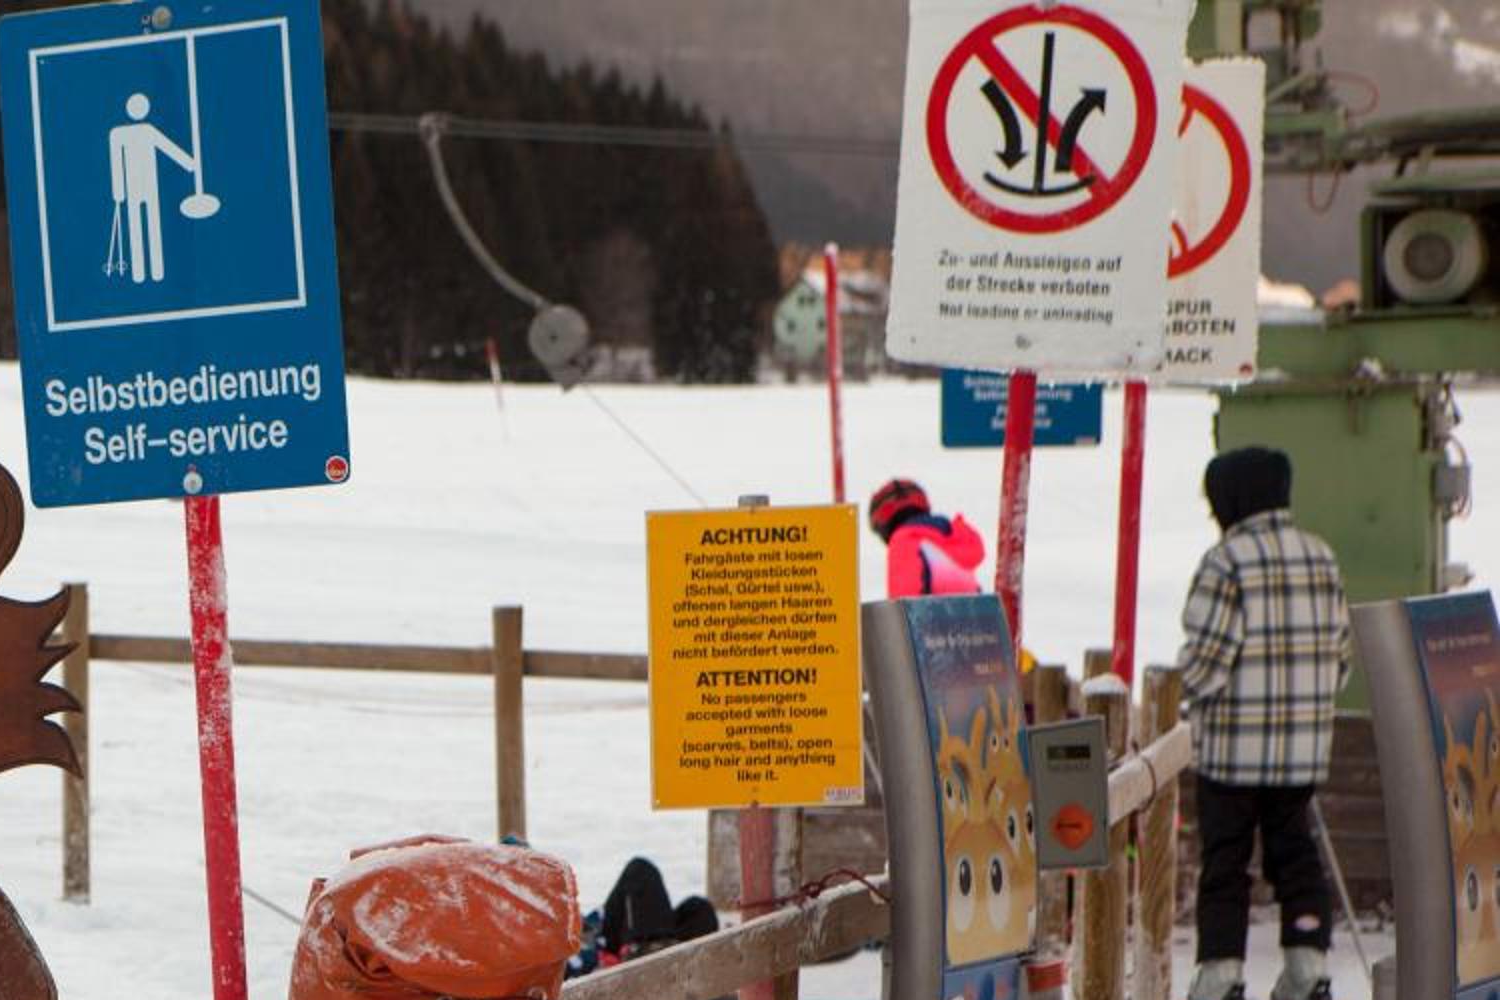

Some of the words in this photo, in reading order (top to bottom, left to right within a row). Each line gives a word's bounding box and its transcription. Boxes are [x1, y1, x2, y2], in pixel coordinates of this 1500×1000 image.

[969, 253, 998, 268] und
[1003, 252, 1092, 273] Aussteigen
[1096, 256, 1122, 272] auf
[946, 275, 972, 292] der
[977, 275, 1036, 294] Strecke
[1041, 277, 1111, 296] verboten
[45, 363, 322, 418] Selbstbedienung
[84, 413, 289, 465] Self-service
[701, 525, 809, 545] ACHTUNG!
[684, 551, 755, 567] Fahrgäste
[757, 550, 781, 562] mit
[785, 550, 824, 561] losen
[691, 565, 818, 582] Kleidungsstücken
[685, 583, 733, 598] (Schal,
[737, 582, 781, 595] Gürtel
[784, 580, 825, 595] usw.),
[672, 600, 727, 613] offenen
[729, 598, 778, 613] langen
[781, 596, 833, 609] Haaren
[672, 616, 700, 629] und
[704, 613, 787, 629] dergleichen
[790, 611, 838, 624] dürfen
[693, 631, 717, 643] mit
[720, 628, 763, 643] dieser
[767, 627, 817, 642] Anlage
[672, 646, 708, 660] nicht
[711, 644, 779, 658] befördert
[781, 642, 840, 656] werden.
[696, 667, 817, 688] ATTENTION!
[701, 692, 721, 705] No
[725, 690, 807, 706] passengers
[685, 707, 752, 722] accepted
[755, 706, 786, 719] with
[789, 705, 828, 718] loose
[725, 721, 794, 738] garments
[683, 738, 747, 755] (scarves,
[749, 737, 793, 752] belts),
[797, 737, 833, 751] open
[679, 755, 711, 770] long
[714, 753, 740, 767] hair
[745, 753, 771, 766] and
[775, 752, 836, 768] anything
[737, 769, 761, 782] like
[765, 769, 779, 782] it.
